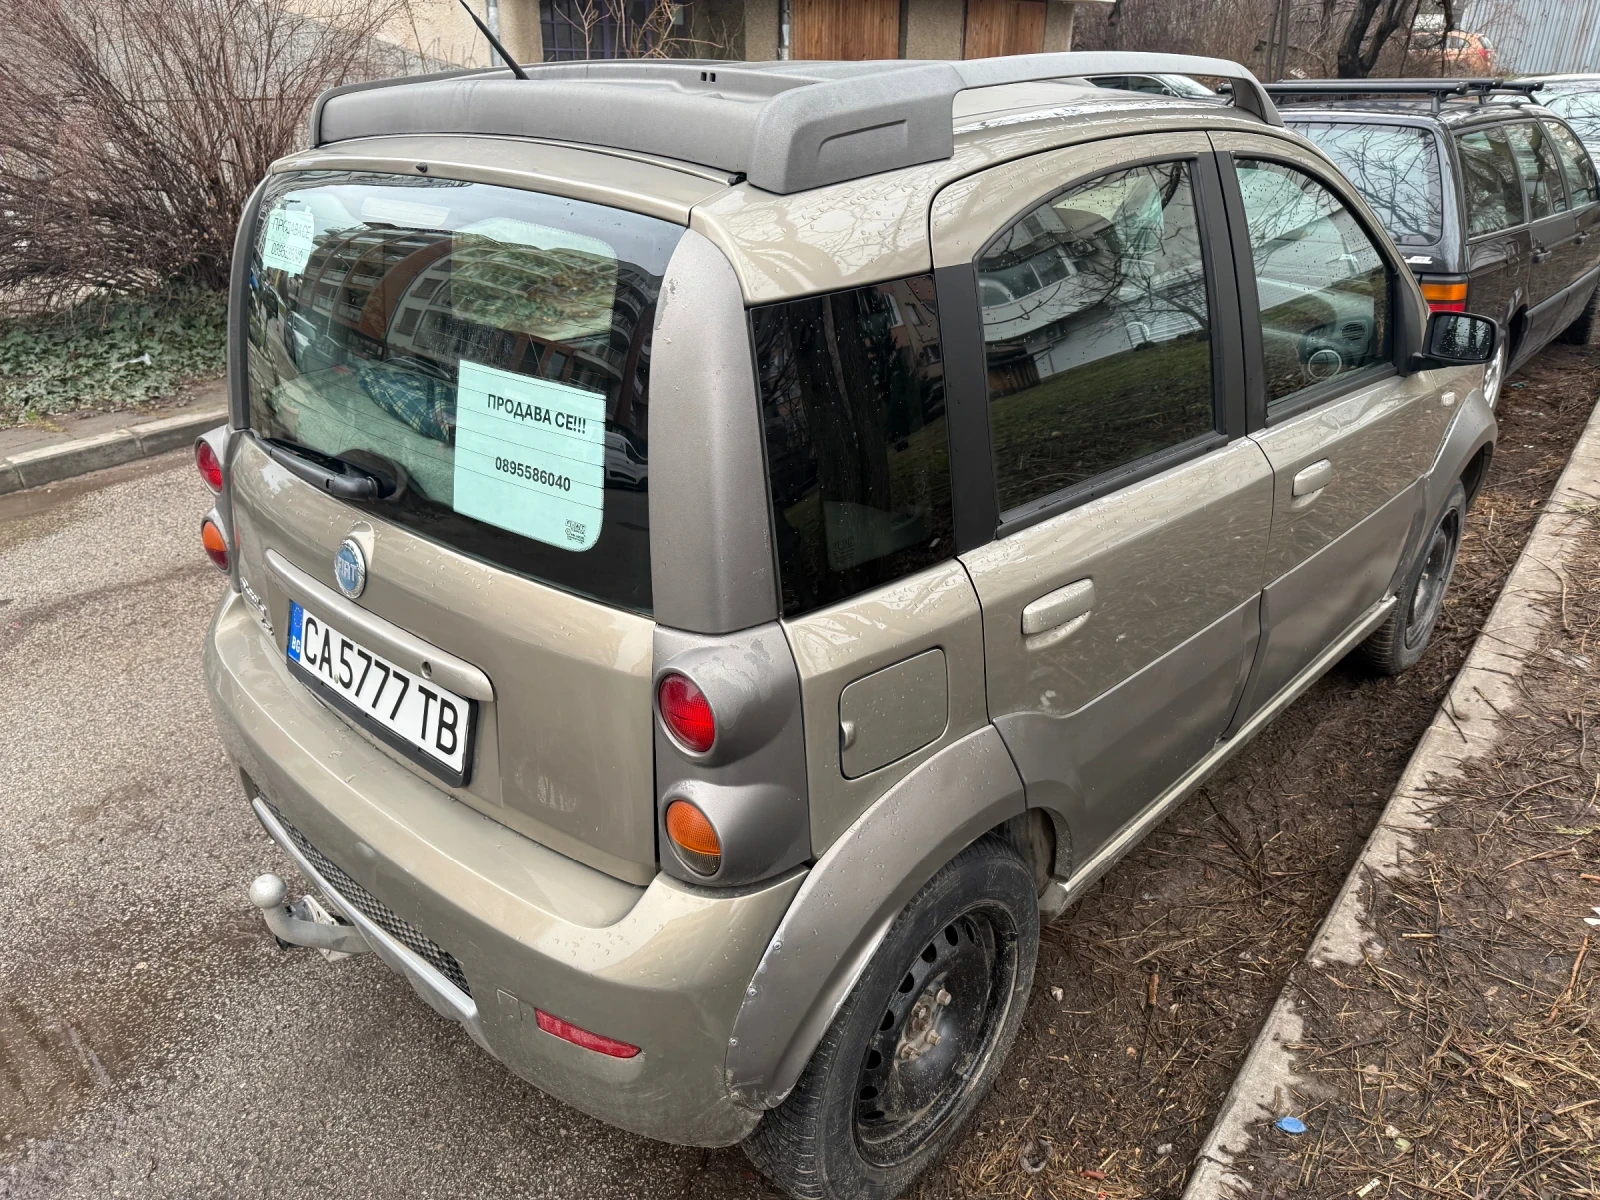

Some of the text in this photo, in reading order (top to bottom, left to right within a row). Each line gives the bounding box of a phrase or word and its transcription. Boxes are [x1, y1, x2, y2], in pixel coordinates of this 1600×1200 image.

[487, 393, 587, 435] ПРОДАВА СЕ!!!
[494, 455, 572, 493] 0895586040
[336, 556, 358, 582] FIAT
[291, 635, 301, 653] BG
